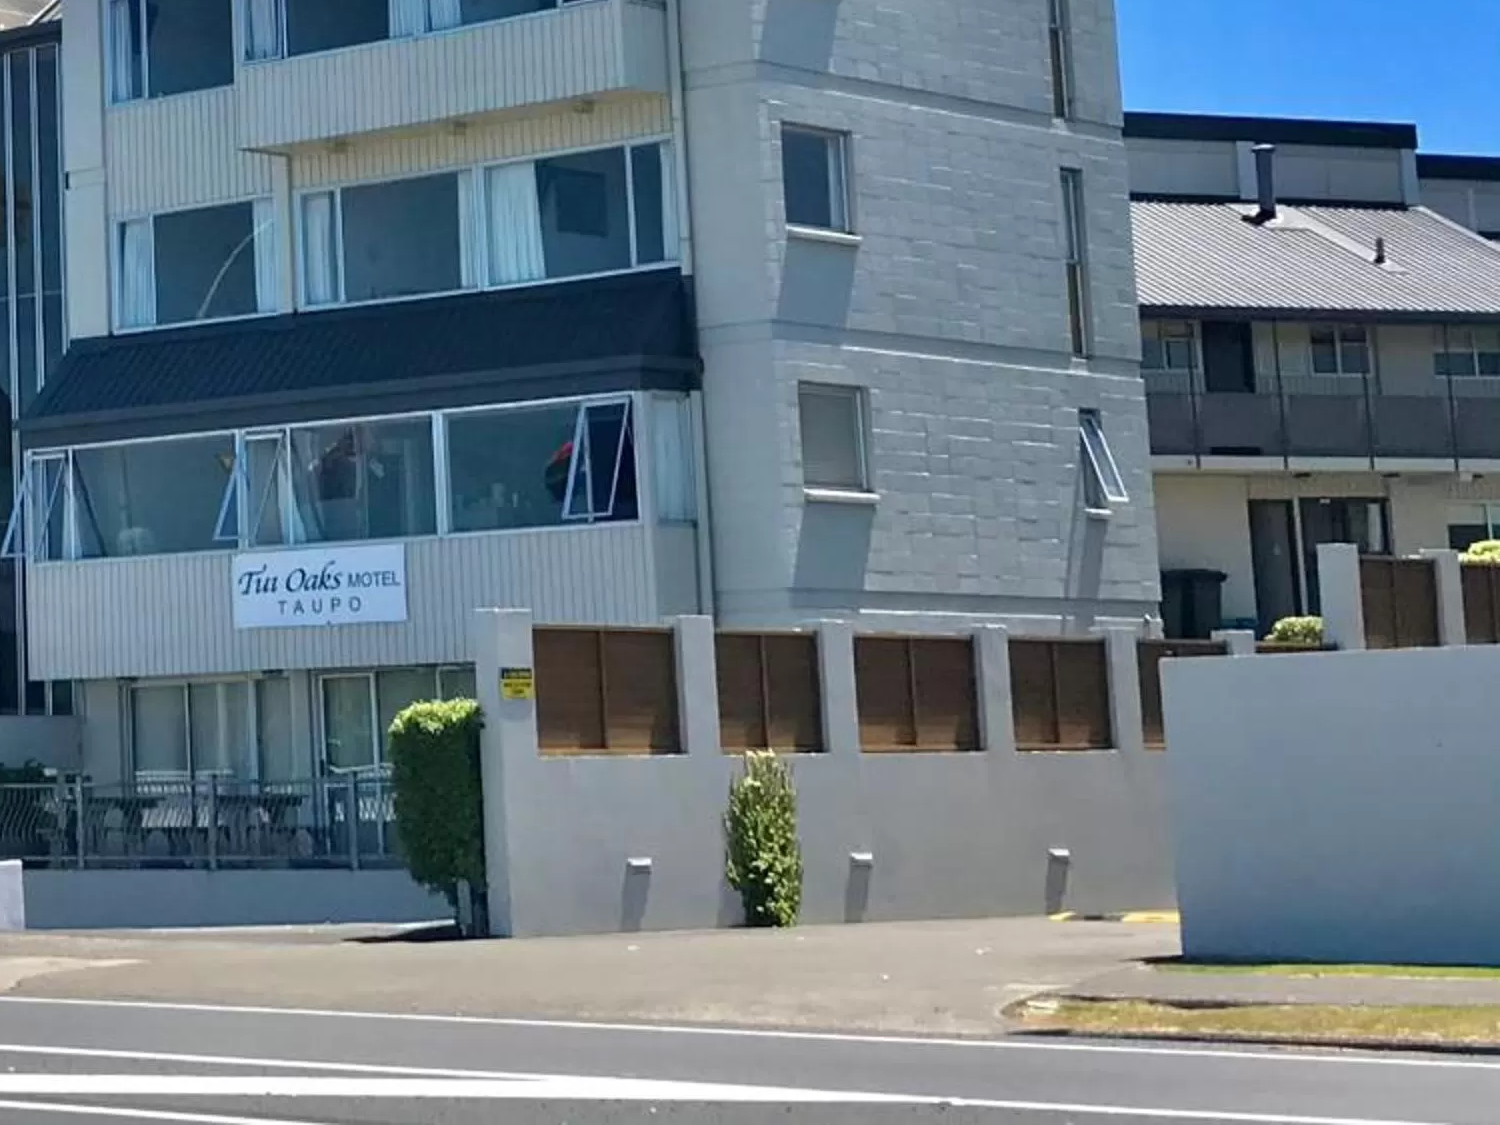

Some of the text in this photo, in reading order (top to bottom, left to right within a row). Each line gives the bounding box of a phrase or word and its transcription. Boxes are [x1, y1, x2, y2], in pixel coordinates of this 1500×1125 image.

[237, 560, 400, 596] Tui Oaks MOTEL
[277, 596, 362, 615] TAUPO
